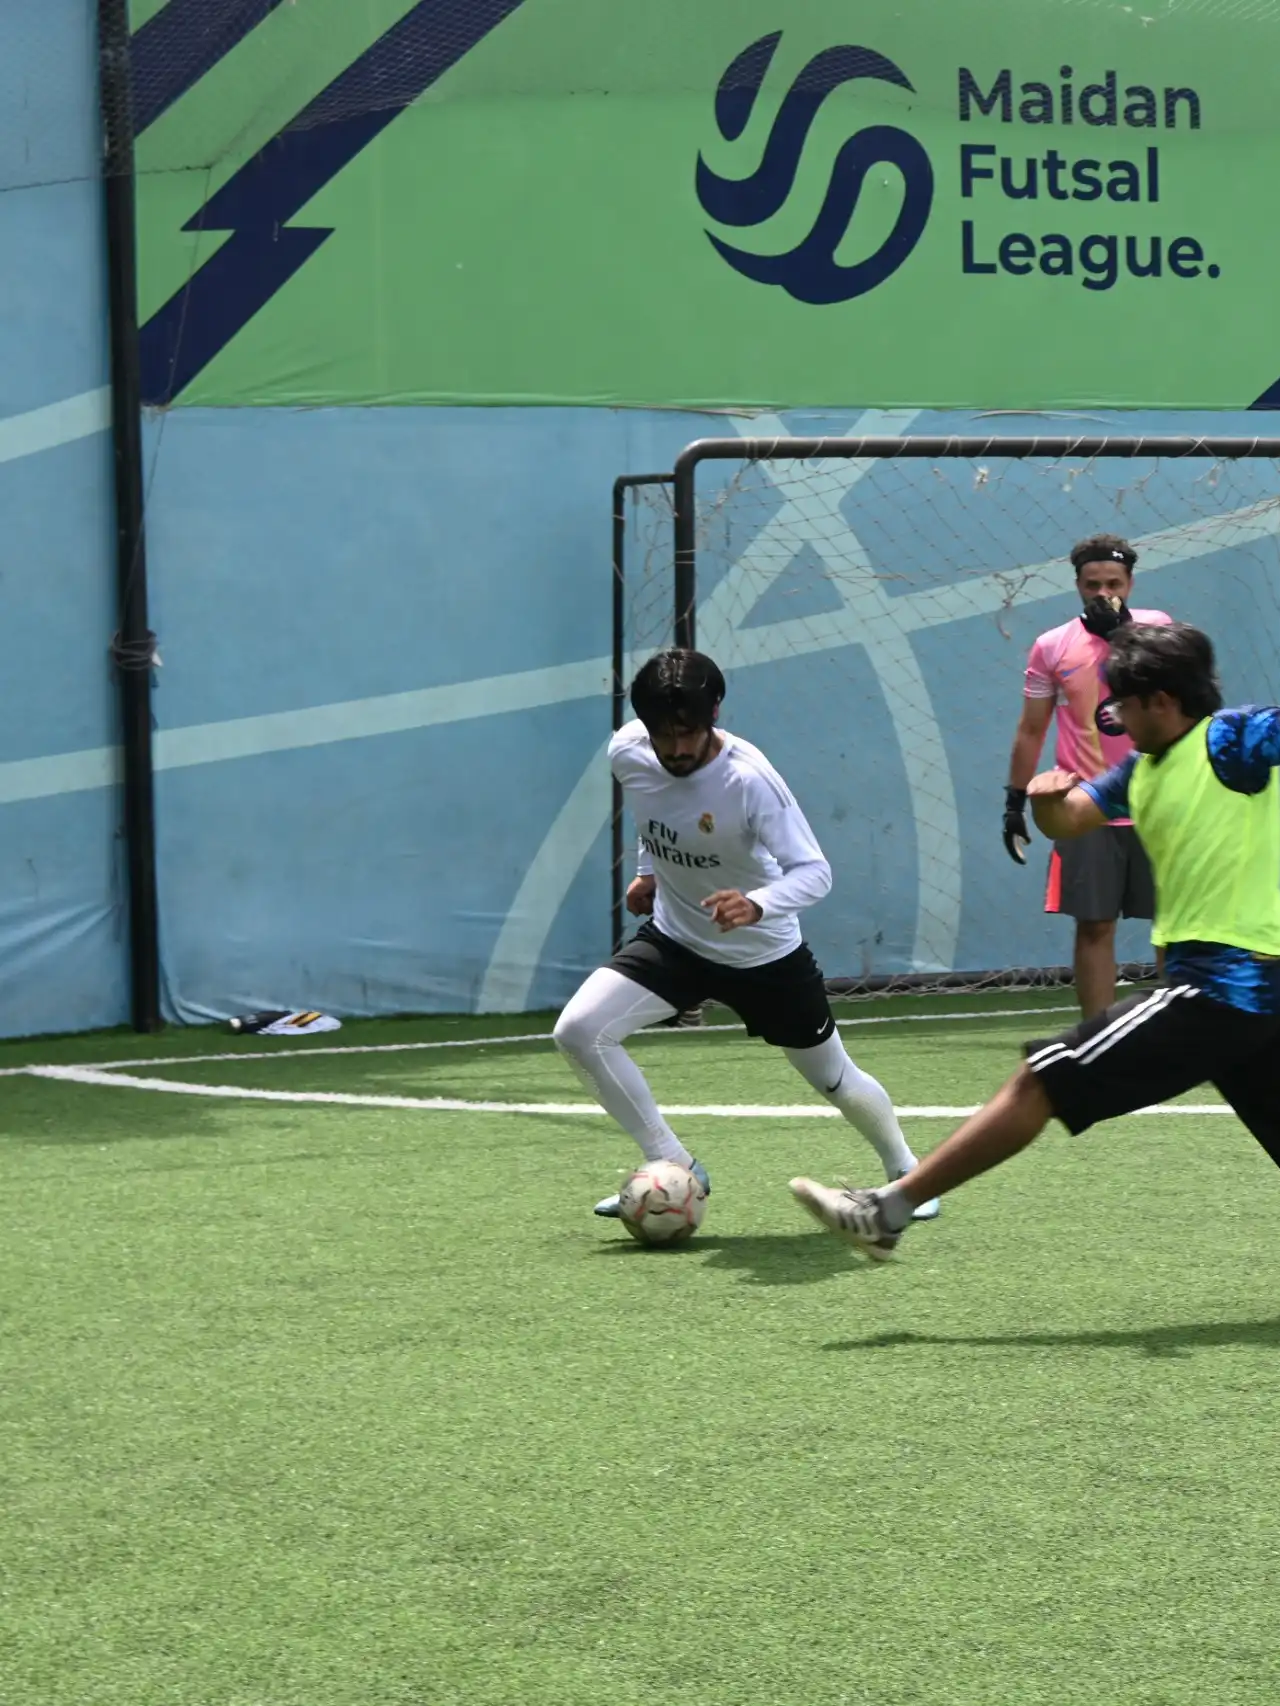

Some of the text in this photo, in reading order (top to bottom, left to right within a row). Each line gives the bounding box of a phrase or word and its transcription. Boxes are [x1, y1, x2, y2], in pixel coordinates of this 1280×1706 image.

[958, 65, 1201, 129] Maidan
[960, 143, 1159, 203] Futsal
[961, 220, 1221, 290] League.
[640, 834, 721, 869] mirates
[648, 818, 679, 845] Fly
